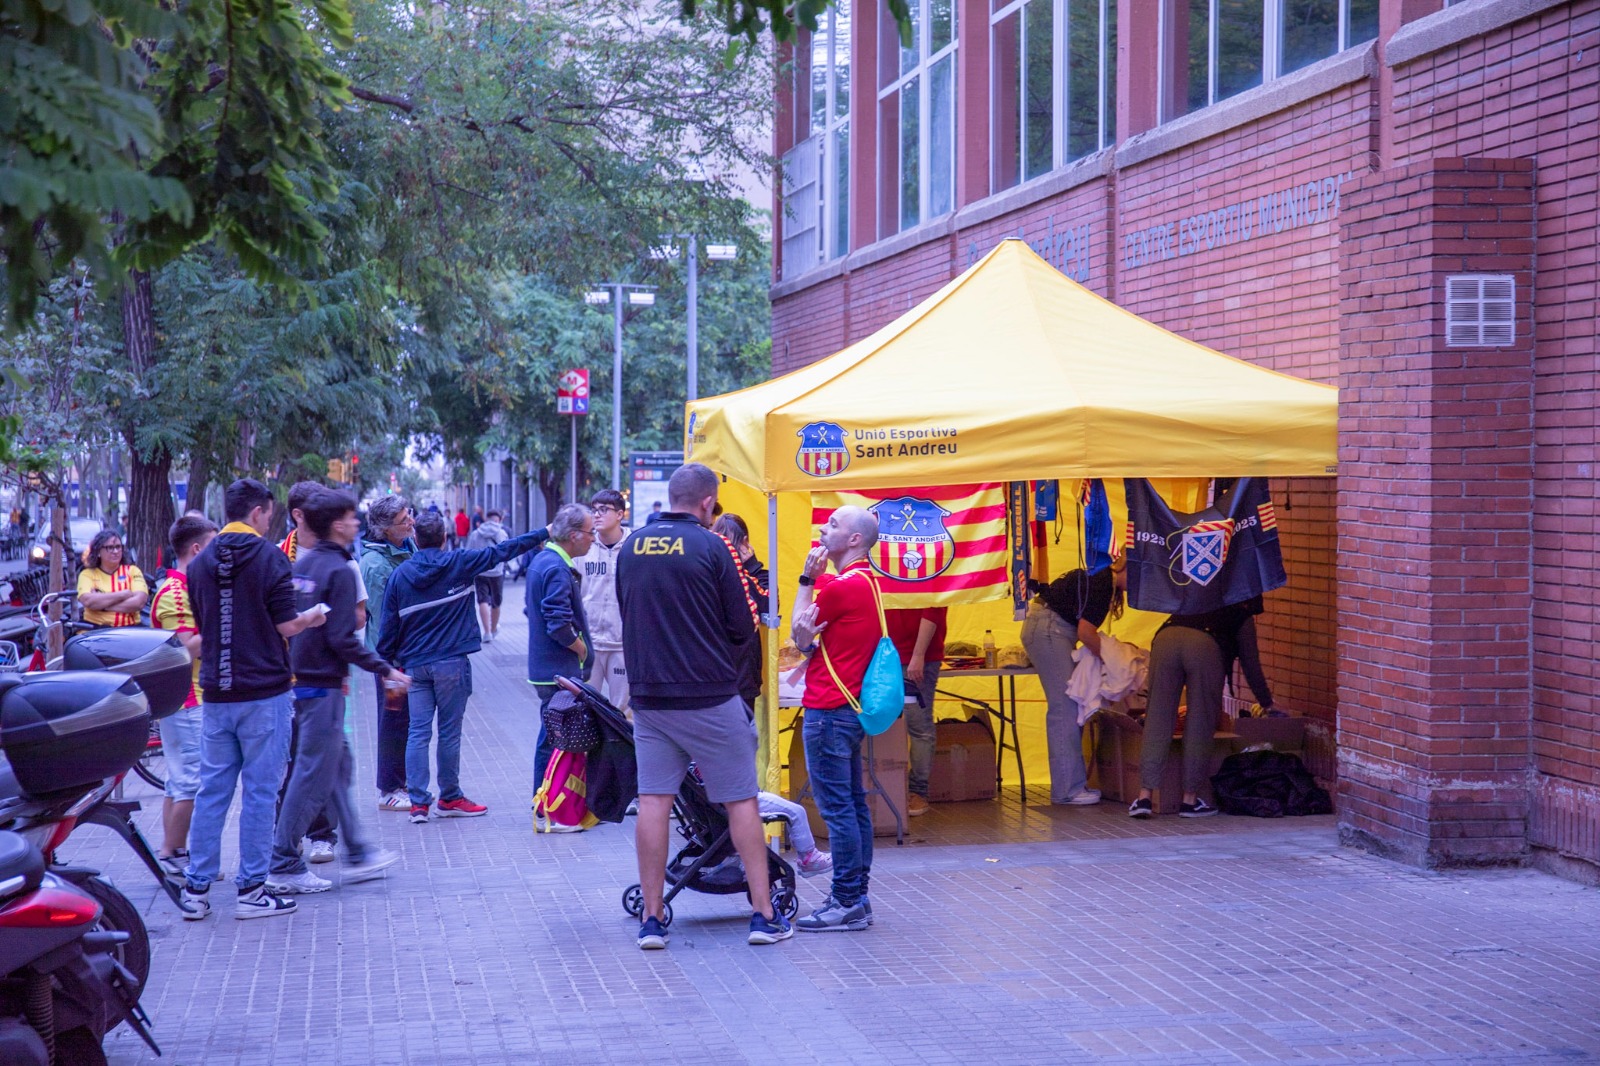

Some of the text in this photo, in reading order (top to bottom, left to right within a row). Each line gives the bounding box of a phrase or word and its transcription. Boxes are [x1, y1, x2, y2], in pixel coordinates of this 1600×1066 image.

[1124, 222, 1176, 269] CENTRE
[1178, 199, 1253, 257] ESPORTIU
[855, 427, 958, 441] Unió Esportiva
[855, 442, 958, 459] Sant Andreu
[1232, 514, 1258, 536] 025
[633, 536, 685, 556] UESA
[915, 534, 946, 542] ANDREU
[1136, 530, 1166, 547] 1925
[219, 588, 233, 645] DEGREES
[219, 649, 233, 691] ELEVEN
